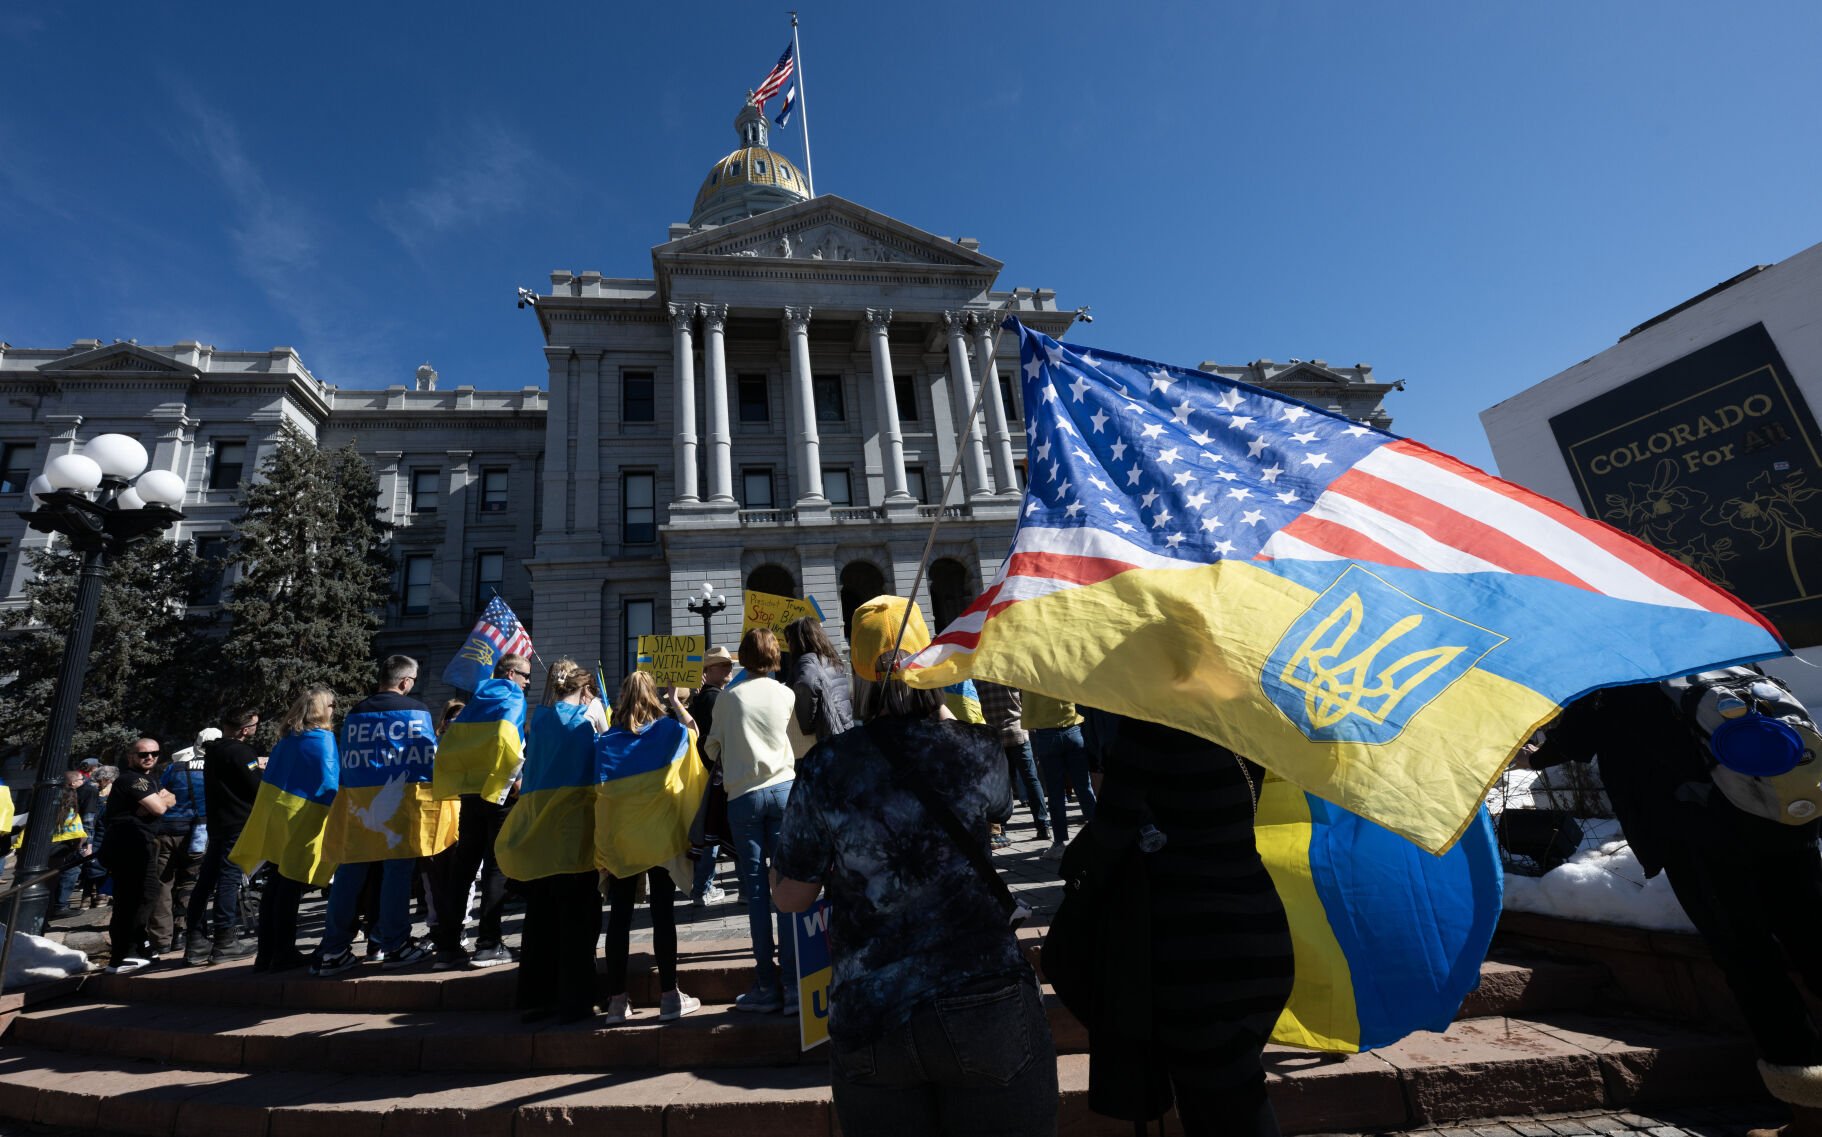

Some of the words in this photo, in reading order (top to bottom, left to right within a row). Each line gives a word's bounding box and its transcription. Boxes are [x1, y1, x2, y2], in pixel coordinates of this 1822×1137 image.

[1590, 394, 1773, 476] COLORADO
[1682, 441, 1735, 473] For
[750, 593, 779, 608] President
[785, 599, 805, 613] Trump
[747, 604, 775, 625] Stop
[638, 635, 649, 655] I
[652, 635, 696, 653] STAND
[652, 654, 684, 669] WITH
[347, 719, 424, 743] PEACE
[381, 744, 436, 767] WAR
